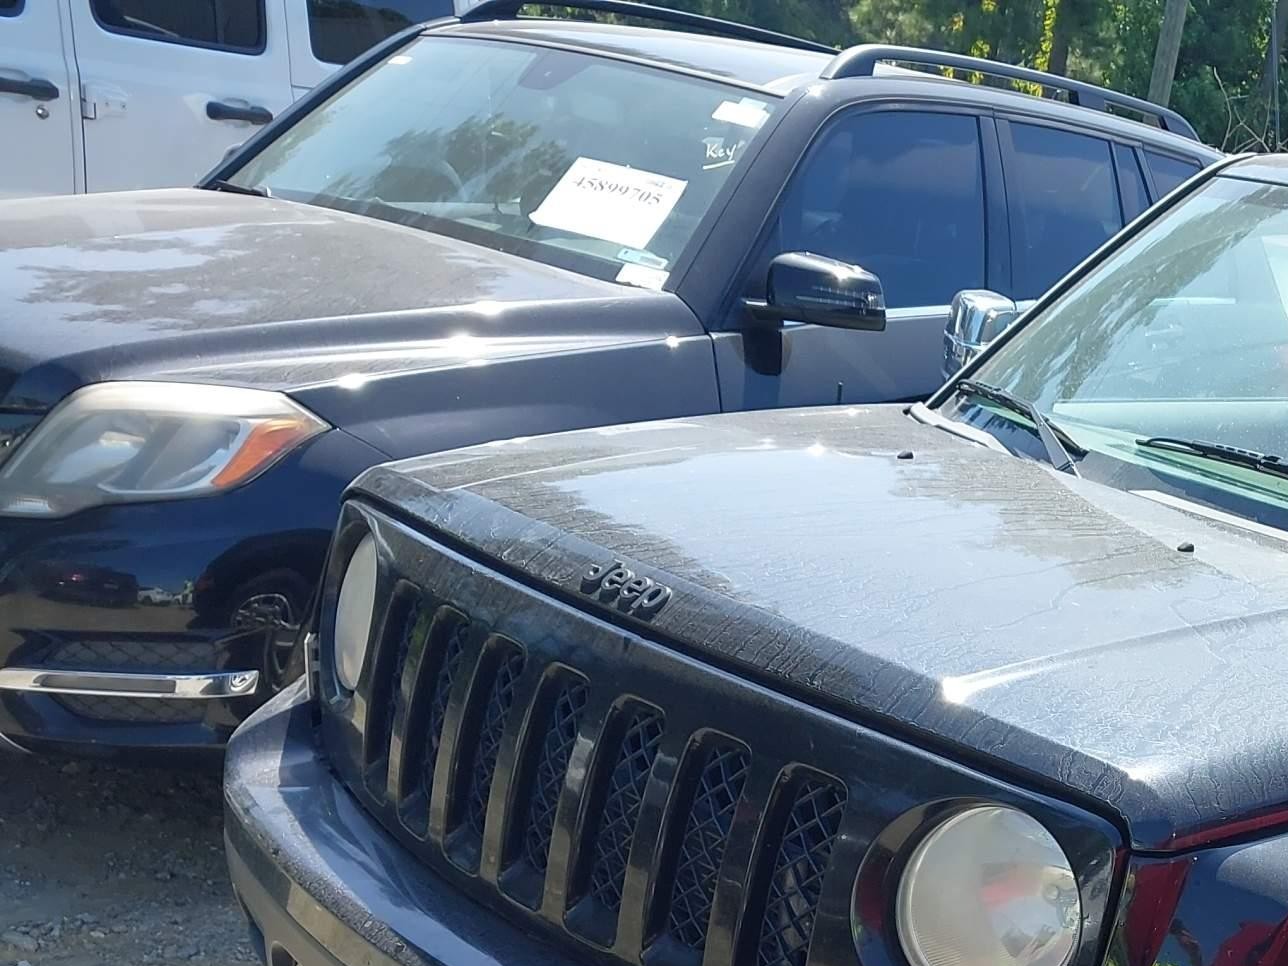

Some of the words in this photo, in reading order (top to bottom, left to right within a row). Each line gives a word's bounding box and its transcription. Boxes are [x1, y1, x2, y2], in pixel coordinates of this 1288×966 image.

[705, 143, 737, 161] Key
[573, 176, 664, 205] 45899705
[581, 558, 673, 619] Jeep
